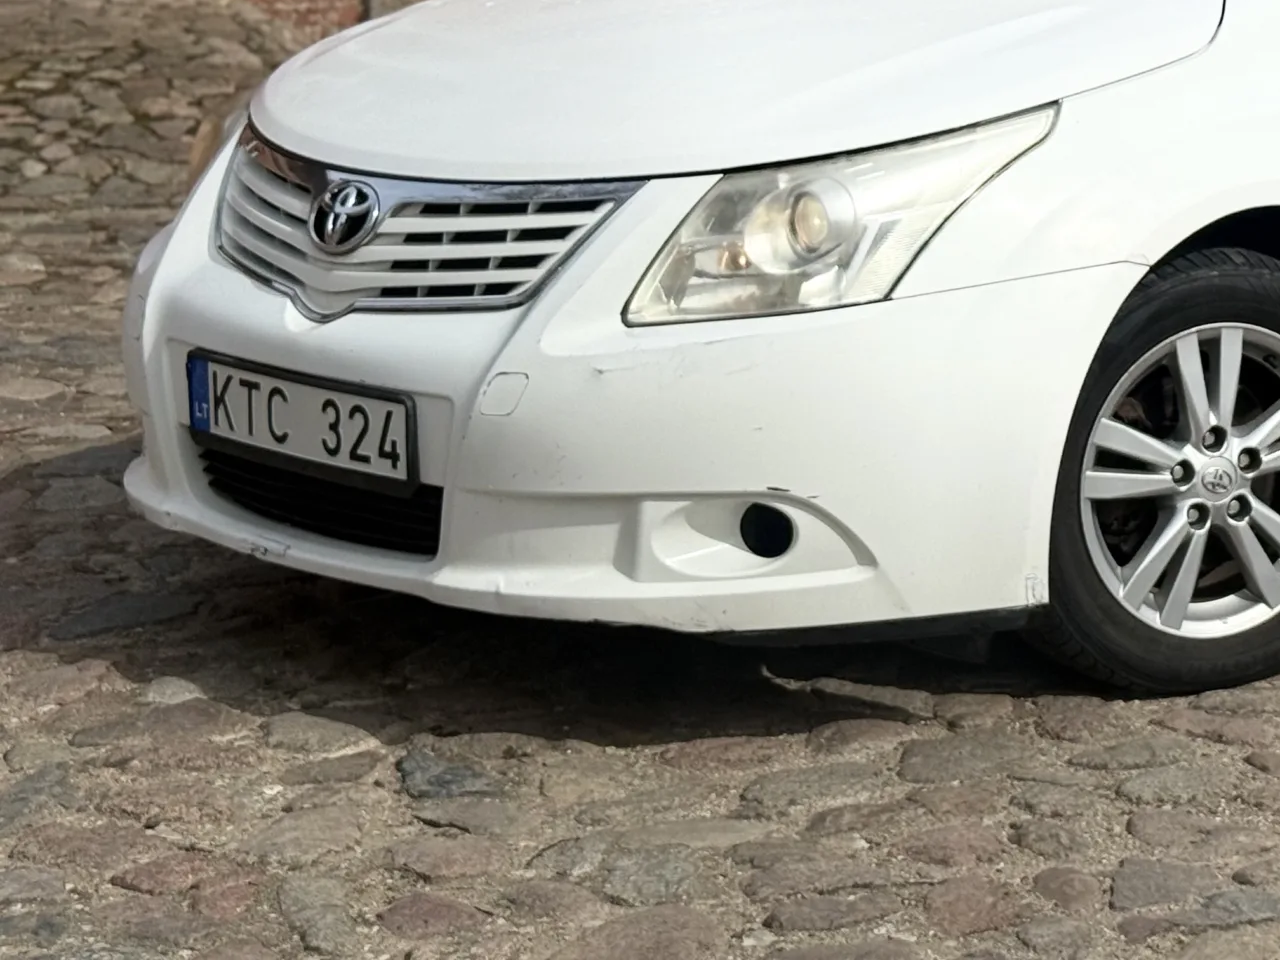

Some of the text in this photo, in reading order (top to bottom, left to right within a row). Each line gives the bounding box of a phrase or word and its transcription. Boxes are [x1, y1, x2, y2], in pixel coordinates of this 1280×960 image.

[195, 401, 208, 419] LT
[212, 370, 400, 470] KTC 324
